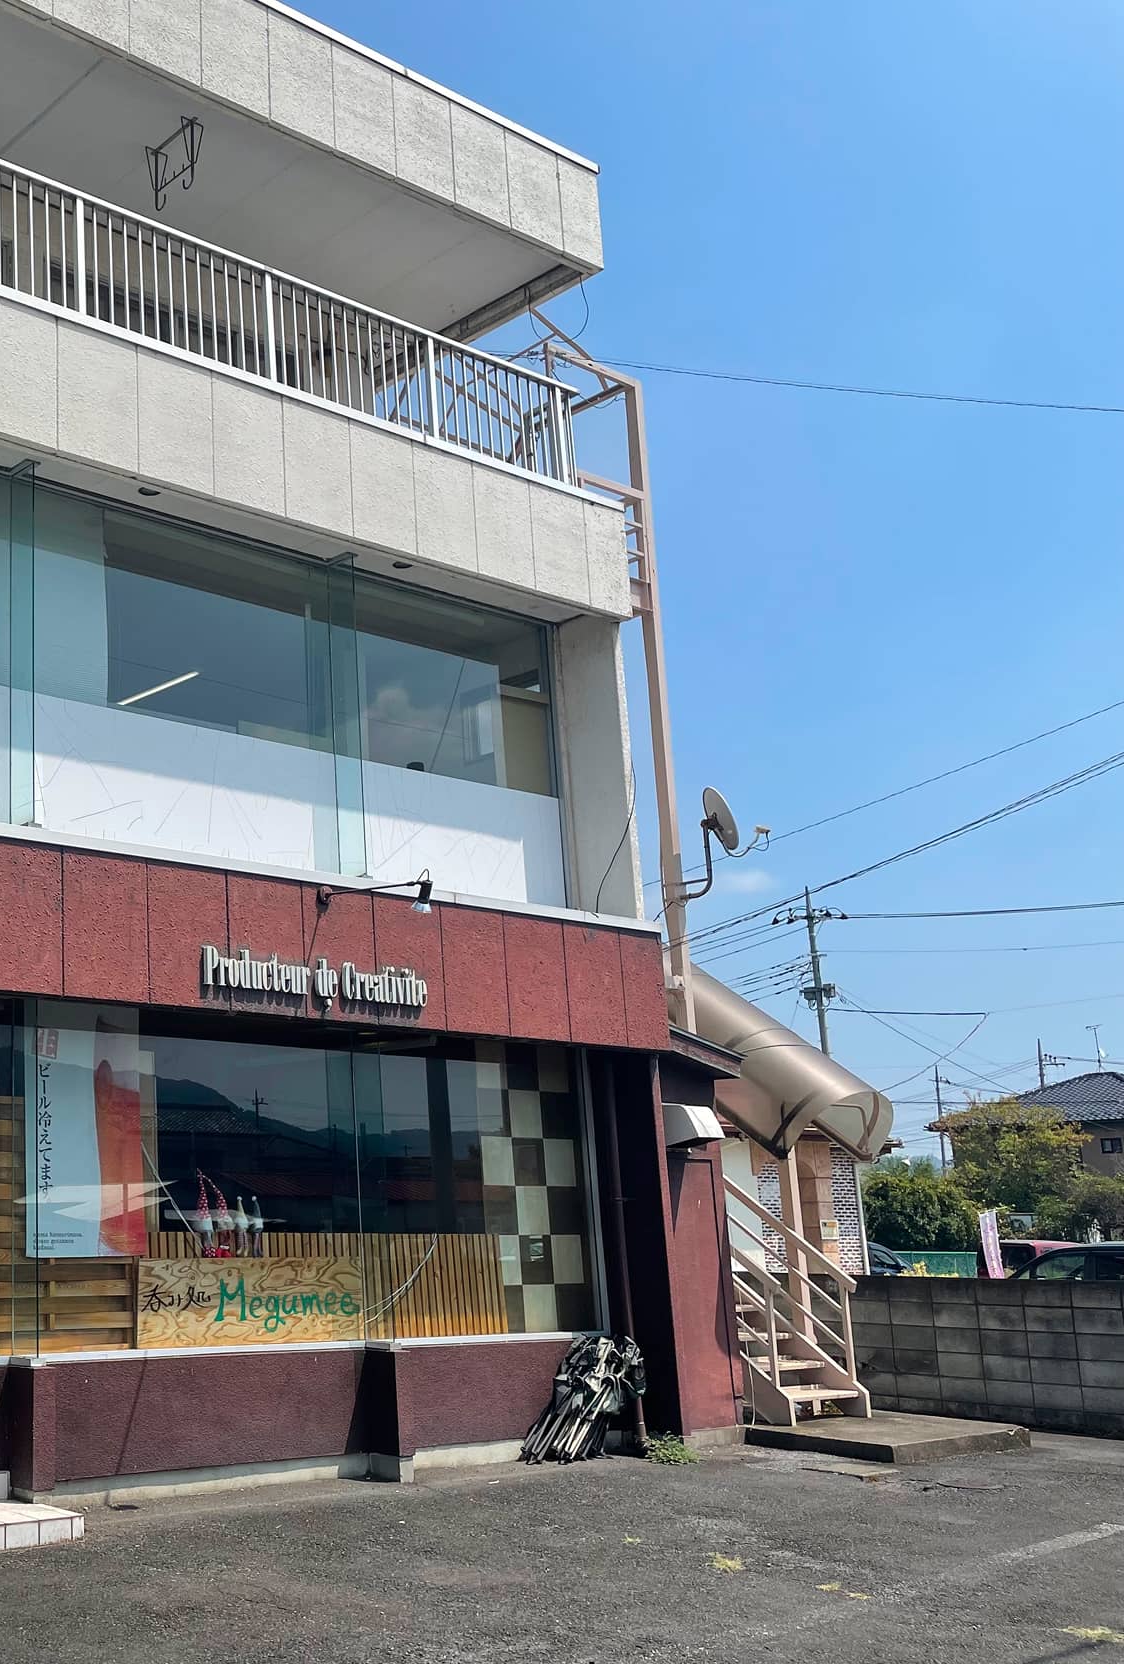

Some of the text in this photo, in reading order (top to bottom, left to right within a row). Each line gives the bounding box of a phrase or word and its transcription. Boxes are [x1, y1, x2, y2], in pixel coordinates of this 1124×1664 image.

[201, 944, 311, 995] Producteur
[37, 1062, 54, 1199] ビール冷えてます
